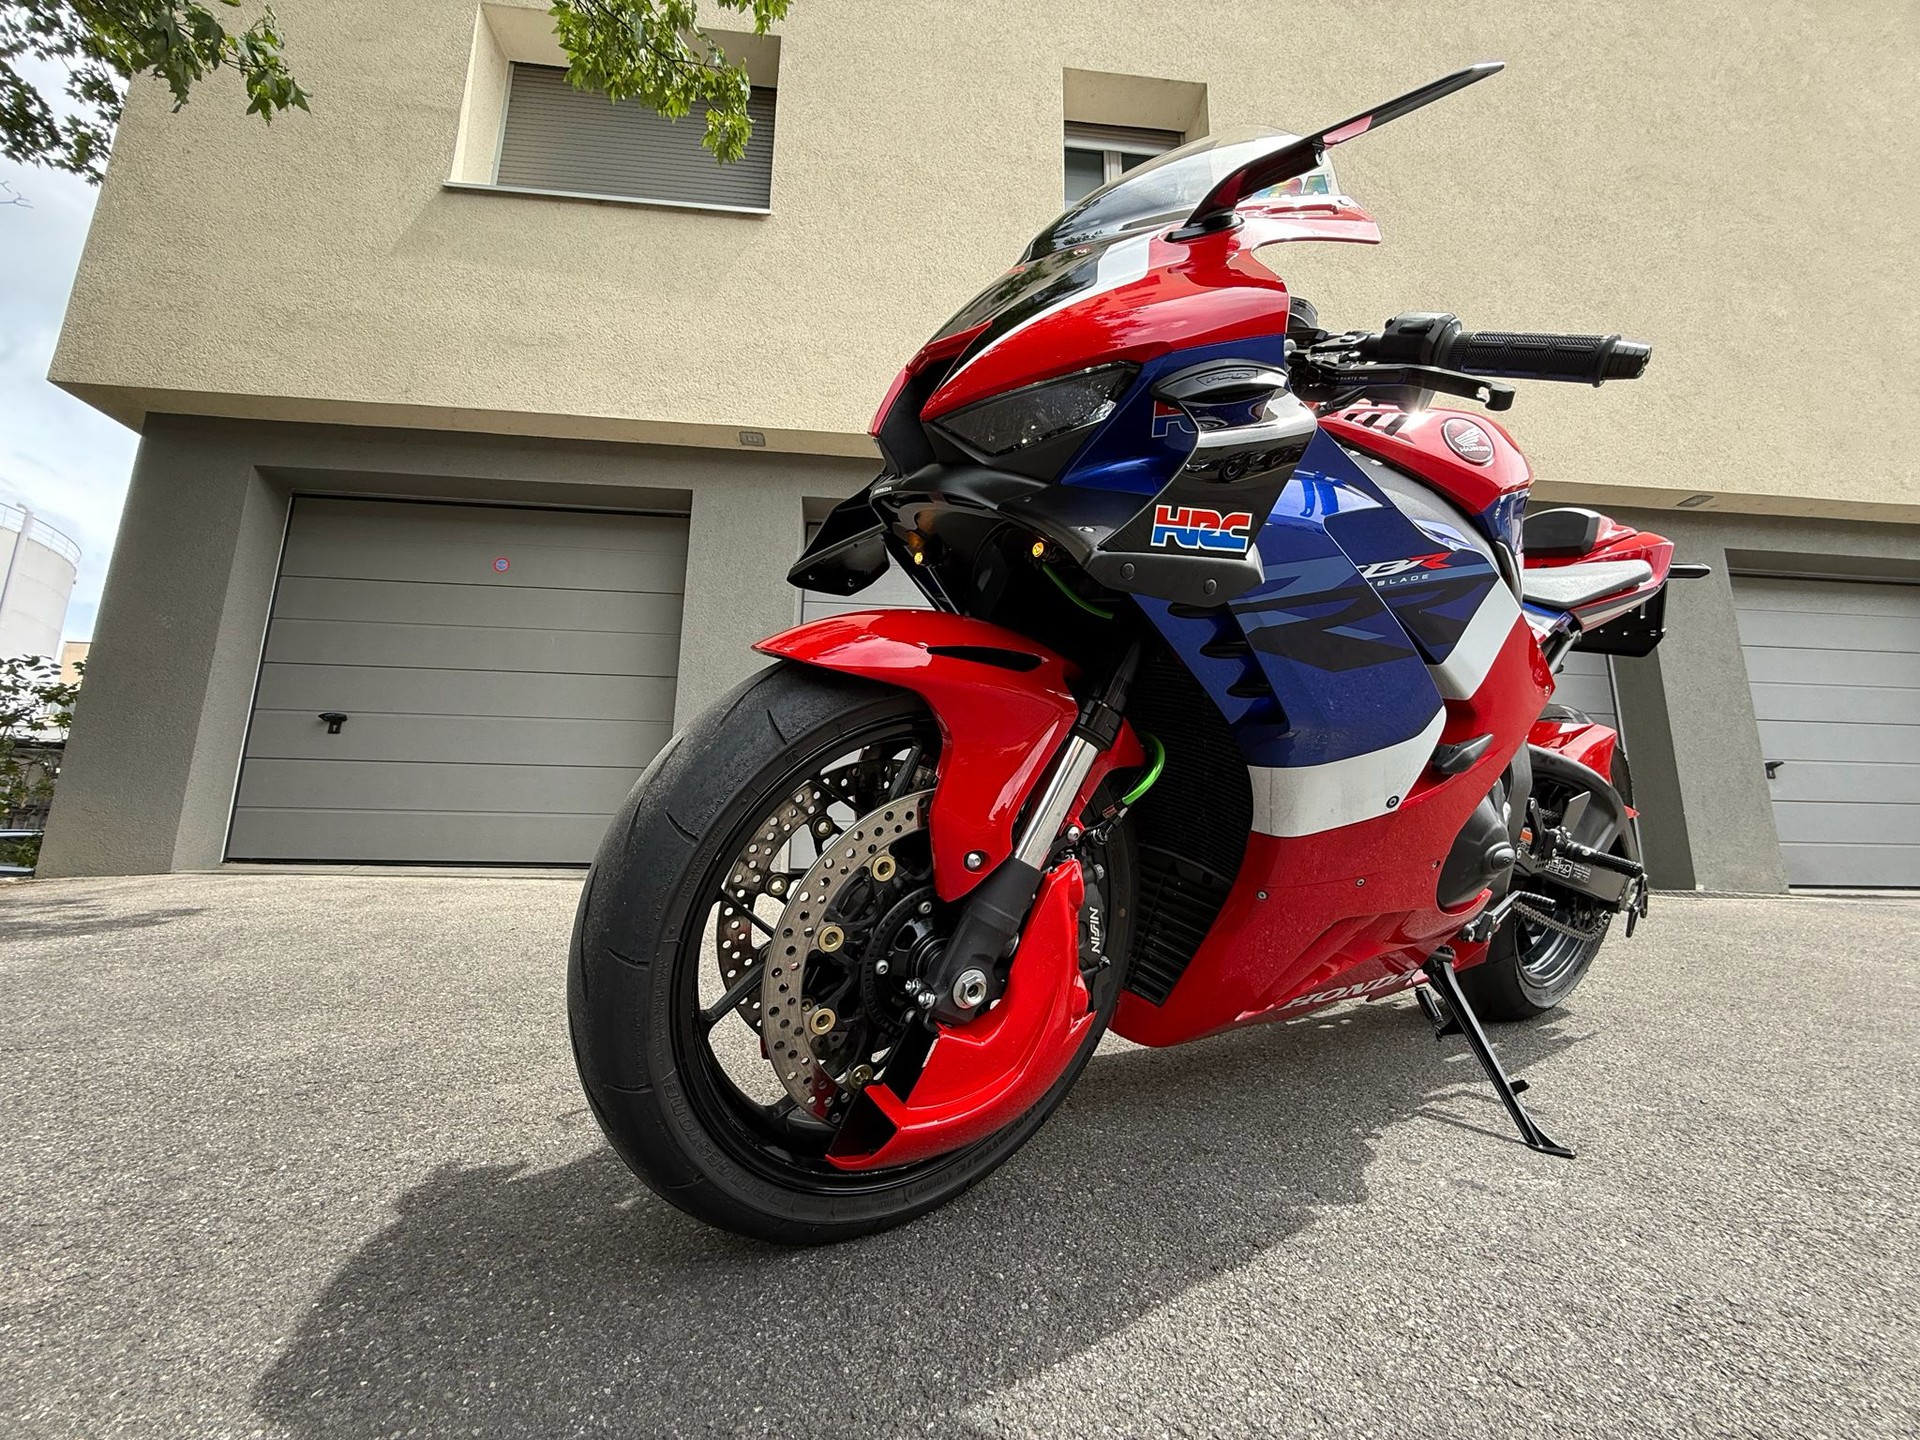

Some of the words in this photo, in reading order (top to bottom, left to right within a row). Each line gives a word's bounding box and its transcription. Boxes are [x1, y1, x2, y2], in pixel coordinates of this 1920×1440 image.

[1150, 504, 1252, 552] HRC
[1370, 574, 1429, 587] BLADE
[1089, 906, 1100, 954] NISSIN
[1277, 968, 1418, 1011] HONDA
[663, 1082, 792, 1207] BRIDGESTONE
